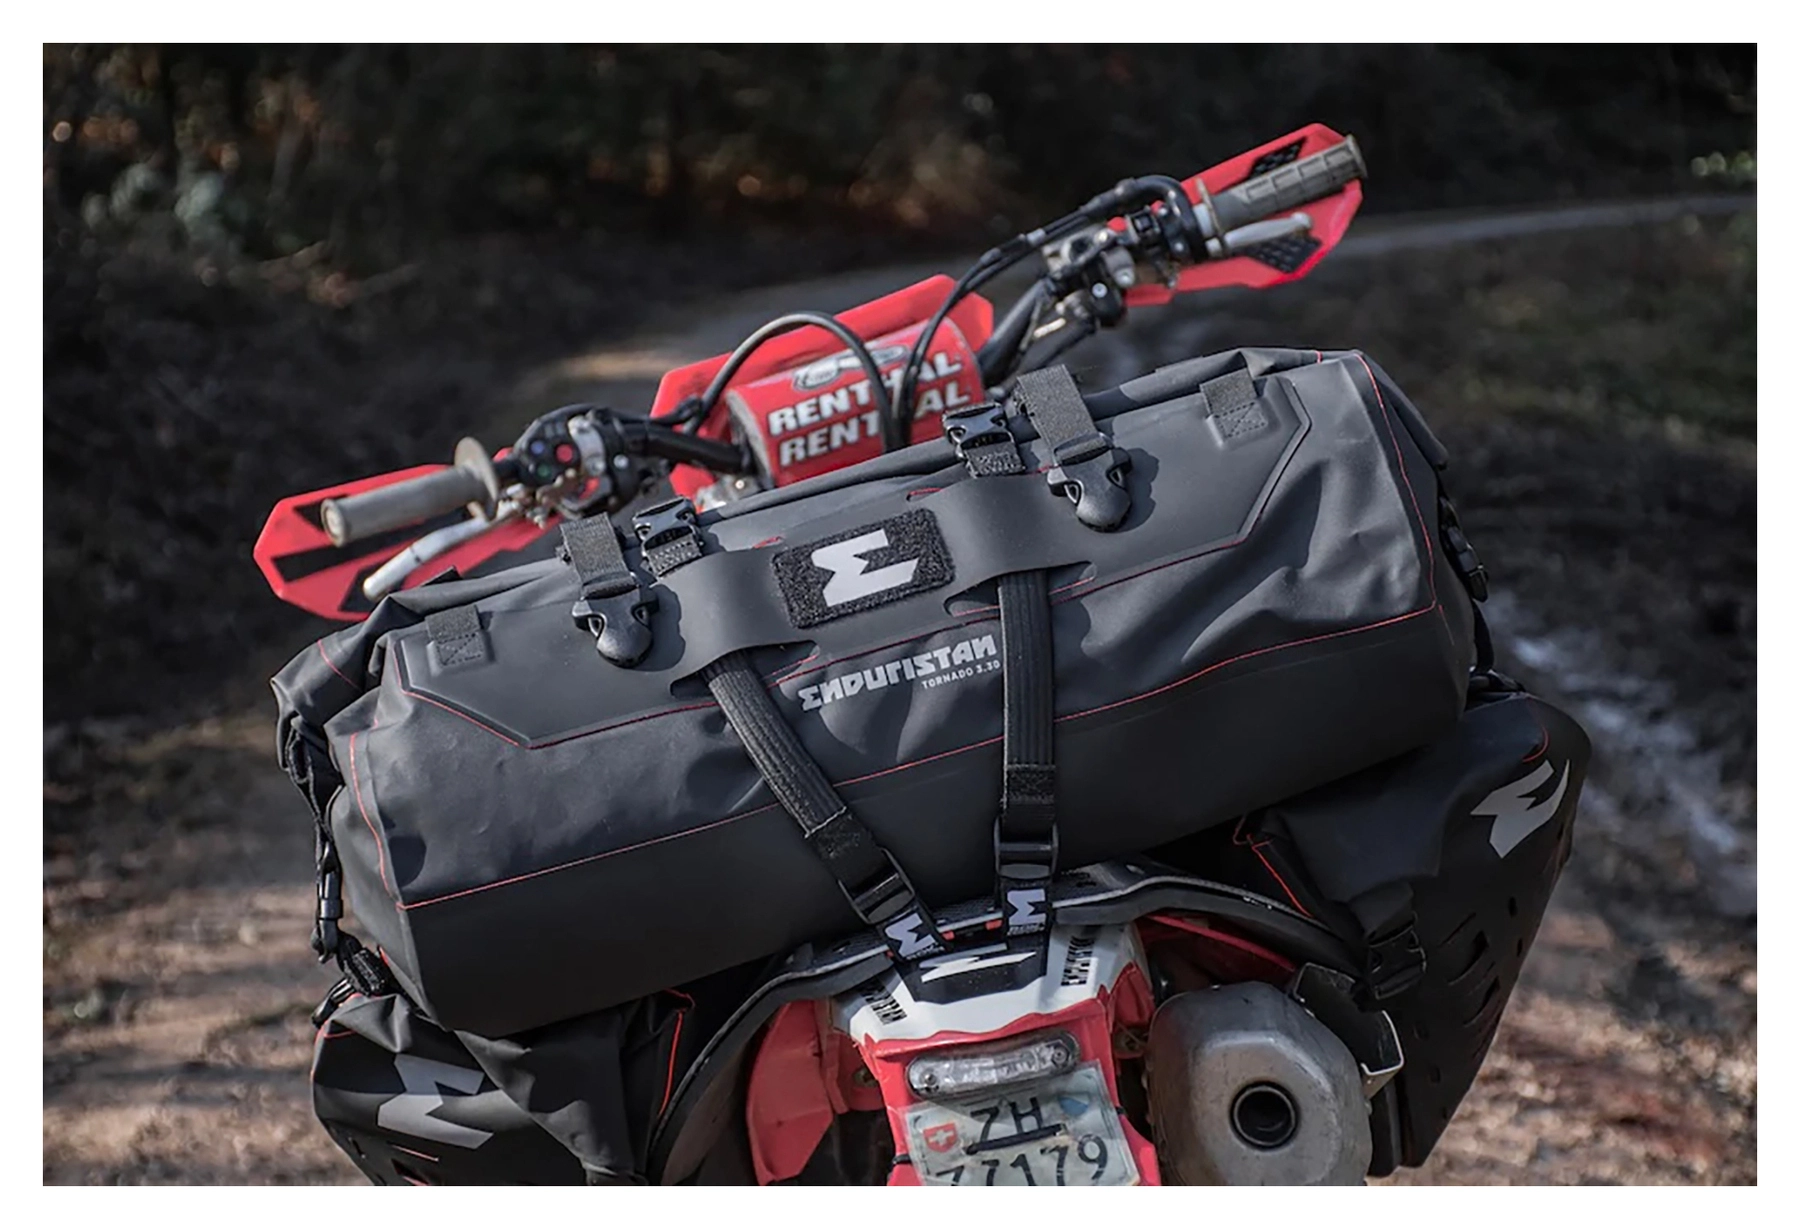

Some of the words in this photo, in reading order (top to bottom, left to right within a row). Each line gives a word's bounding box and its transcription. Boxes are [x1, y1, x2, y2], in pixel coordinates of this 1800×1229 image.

[780, 380, 970, 467] RENTAL
[798, 634, 997, 711] ENDURISTAN
[921, 667, 974, 690] TORNADO
[976, 660, 1001, 674] 3.30
